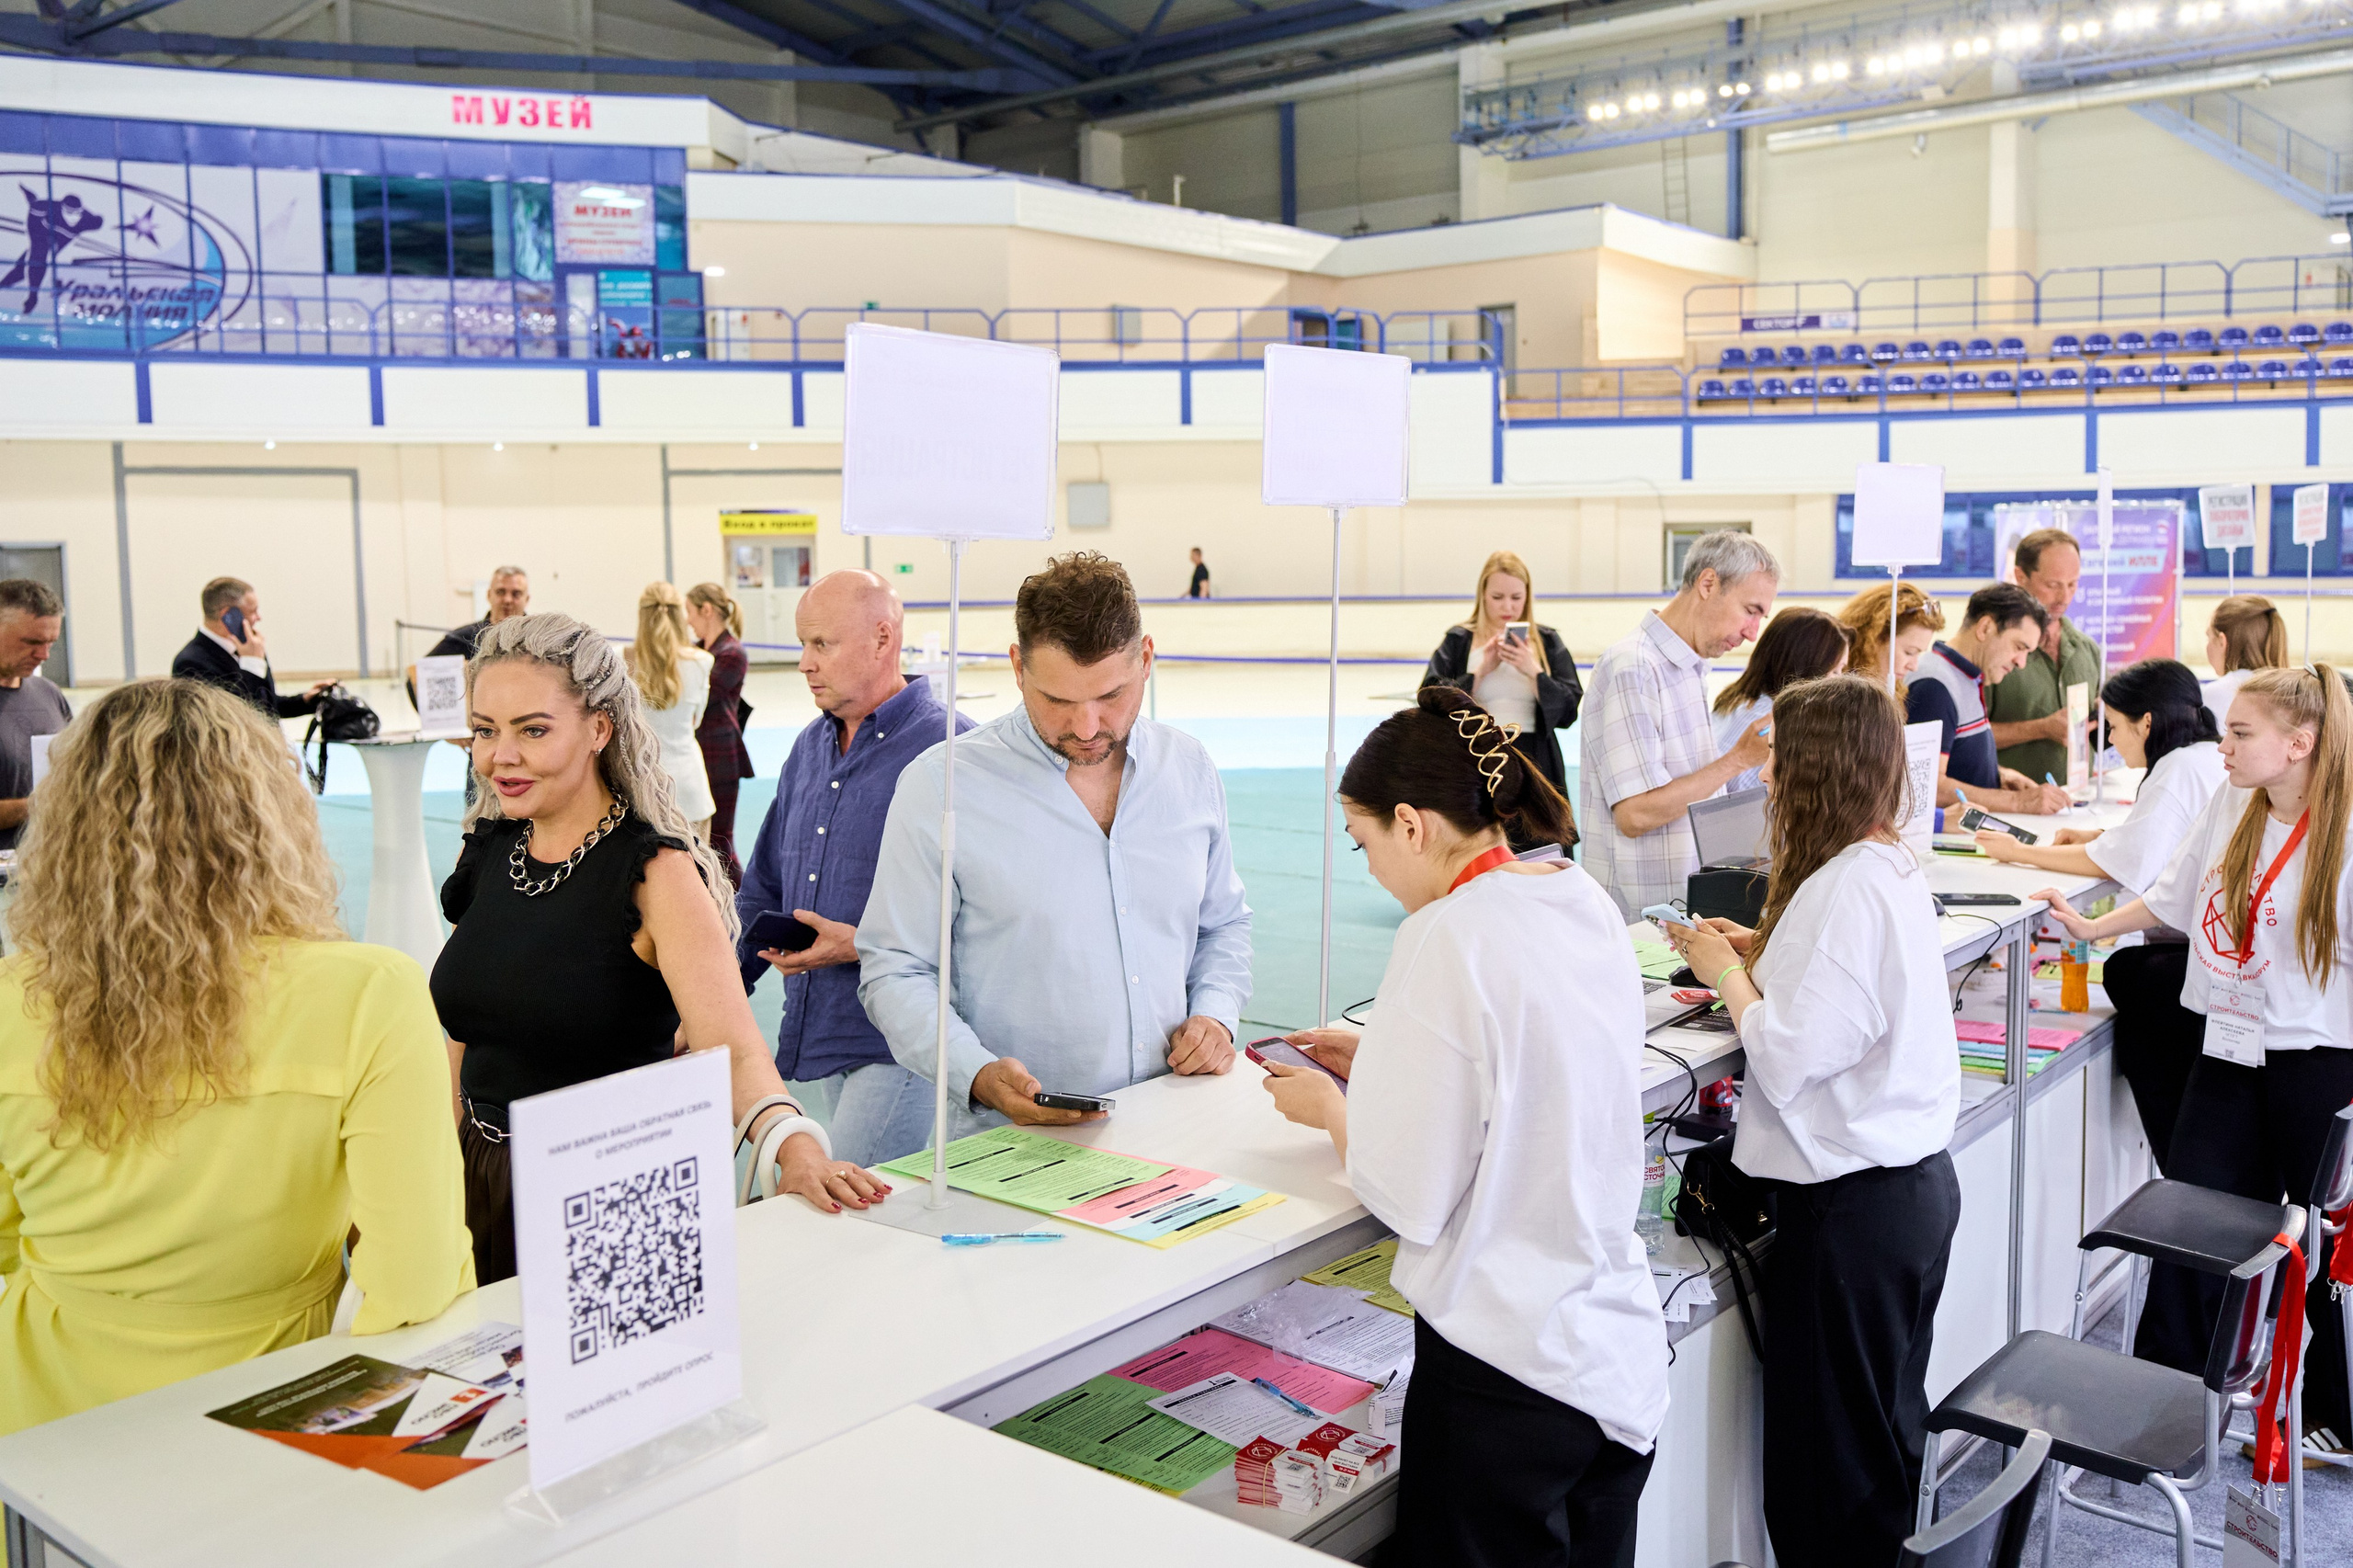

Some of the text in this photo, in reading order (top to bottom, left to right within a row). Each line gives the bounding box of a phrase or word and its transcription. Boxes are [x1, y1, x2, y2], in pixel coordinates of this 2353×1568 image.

[452, 95, 593, 130] МУЗЕЙ
[2210, 1004, 2259, 1021] СТРОИТЕЛЬСТВО
[549, 1100, 712, 1156] НАМ ВАЖНА ВАША ОБРАТНАЯ СВЯЗЬ
[1644, 1164, 1665, 1174] СВЯТО
[2226, 1520, 2279, 1558] СТРОИТЕЛЬСТВО
